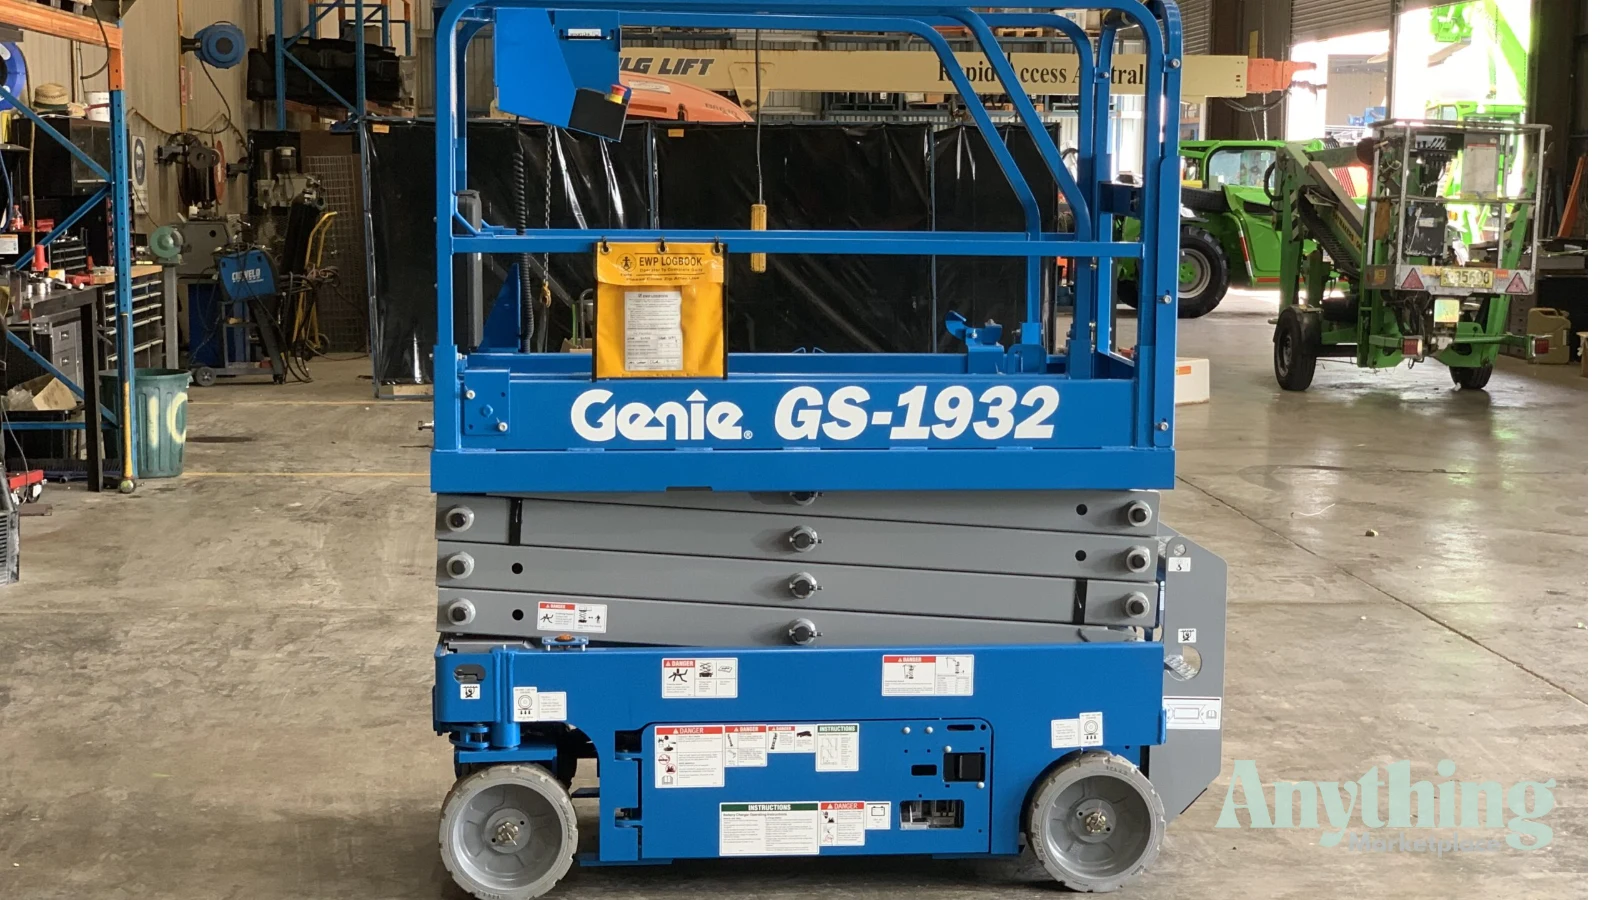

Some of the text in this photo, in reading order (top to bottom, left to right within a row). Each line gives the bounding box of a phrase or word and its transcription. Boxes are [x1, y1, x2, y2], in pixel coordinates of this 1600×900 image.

[620, 58, 715, 75] LG LIFT
[938, 60, 996, 82] Rpid
[1011, 61, 1066, 83] ccess
[640, 256, 703, 266] EWP LOGBOOK
[571, 385, 1060, 442] Genie GS-1932
